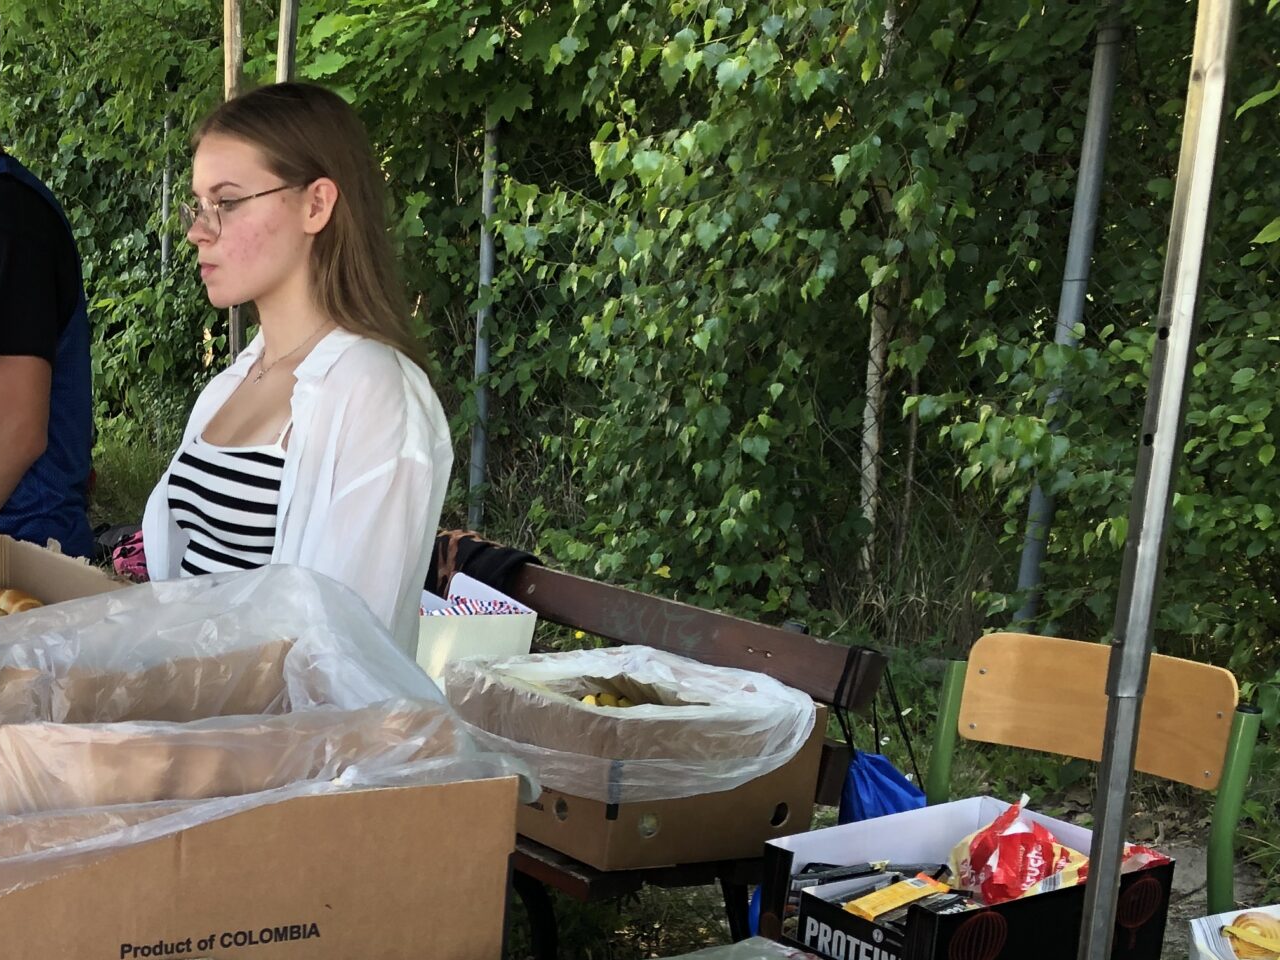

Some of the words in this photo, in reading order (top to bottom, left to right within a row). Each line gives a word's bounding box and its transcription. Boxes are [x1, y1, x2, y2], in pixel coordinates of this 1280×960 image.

[120, 938, 192, 959] Product
[197, 934, 216, 951] of
[220, 923, 321, 949] COLOMBIA
